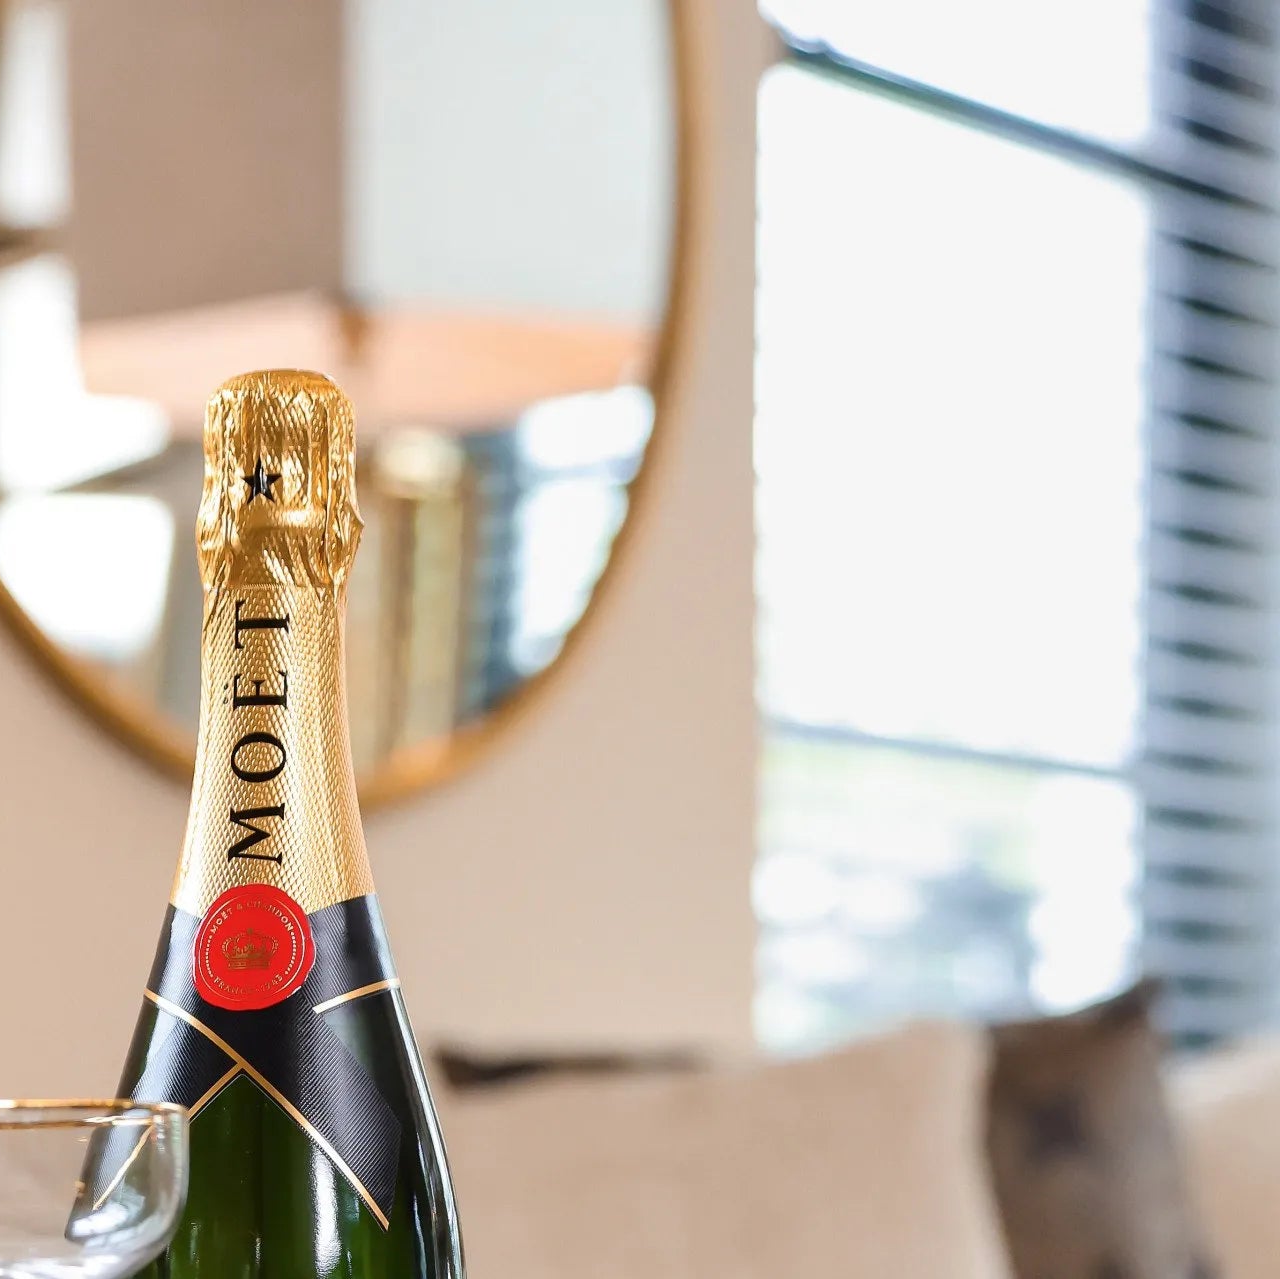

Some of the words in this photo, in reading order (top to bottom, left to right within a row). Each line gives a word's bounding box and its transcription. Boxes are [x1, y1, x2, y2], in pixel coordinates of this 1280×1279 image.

[222, 600, 291, 865] MOËT
[246, 900, 295, 932] CHNDON
[213, 975, 252, 995] FRANC
